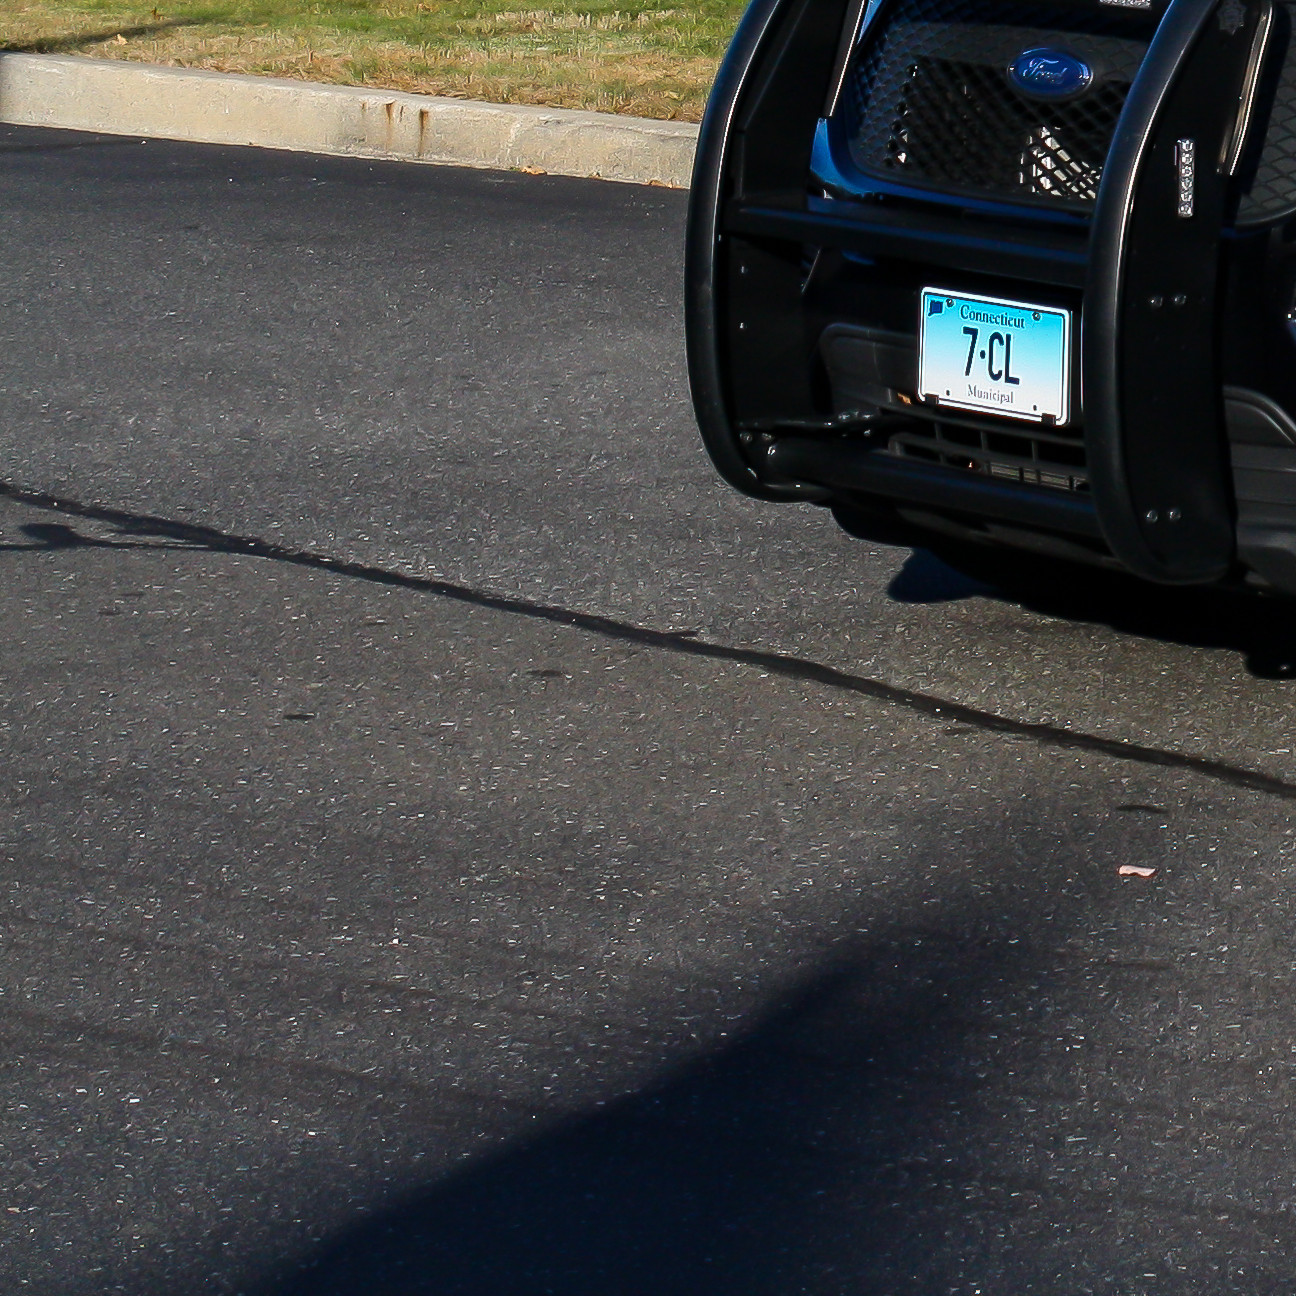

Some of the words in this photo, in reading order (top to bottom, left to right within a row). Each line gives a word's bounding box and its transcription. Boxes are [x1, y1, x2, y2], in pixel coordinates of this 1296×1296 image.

[1022, 57, 1068, 85] Ford
[960, 304, 1025, 329] Connecticut
[967, 384, 1014, 404] Municipal
